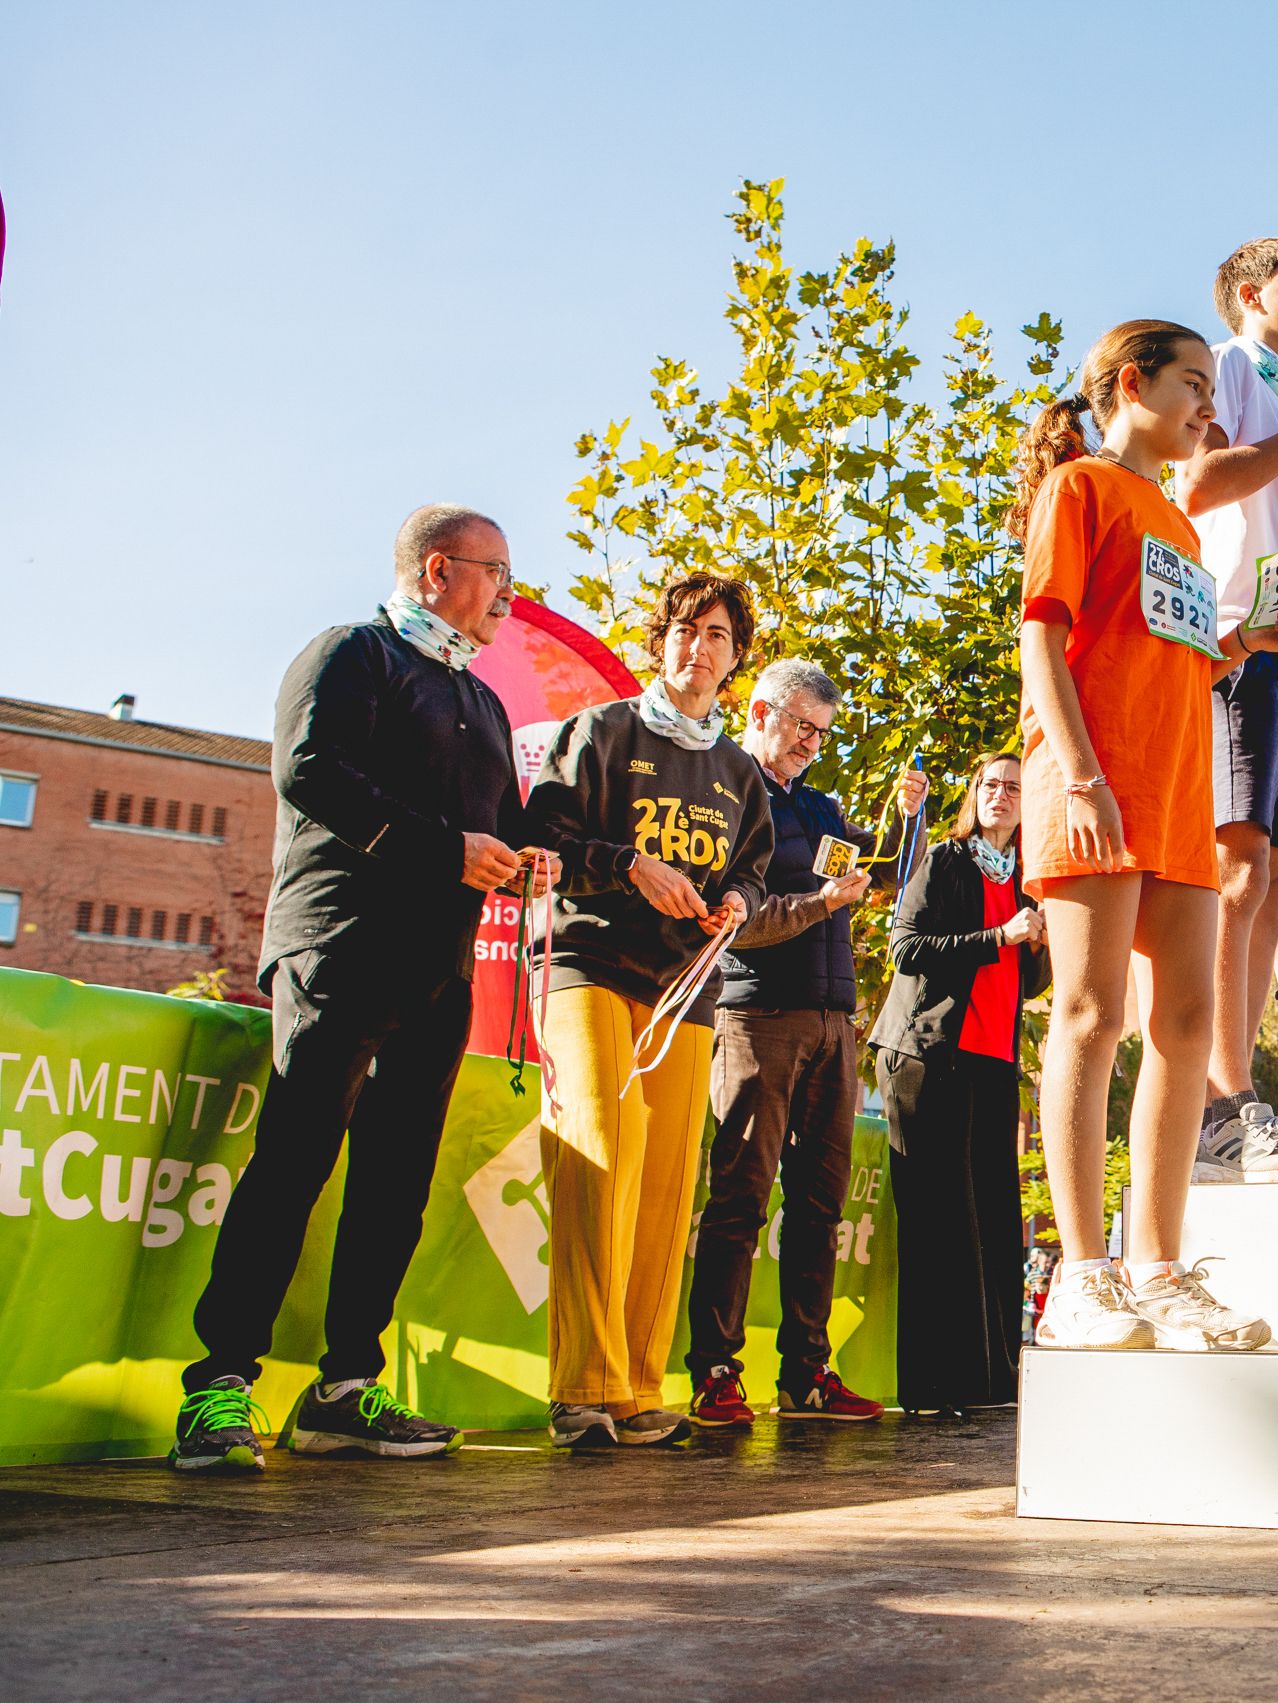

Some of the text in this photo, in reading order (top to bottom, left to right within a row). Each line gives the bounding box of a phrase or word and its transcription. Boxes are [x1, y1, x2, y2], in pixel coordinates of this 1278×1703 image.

[1149, 554, 1180, 582] CROS
[1152, 590, 1210, 635] 2927
[630, 760, 655, 771] OMET
[689, 804, 724, 820] Ciutat de
[690, 812, 709, 822] Sant
[635, 828, 730, 871] CROS
[851, 1166, 882, 1205] DE
